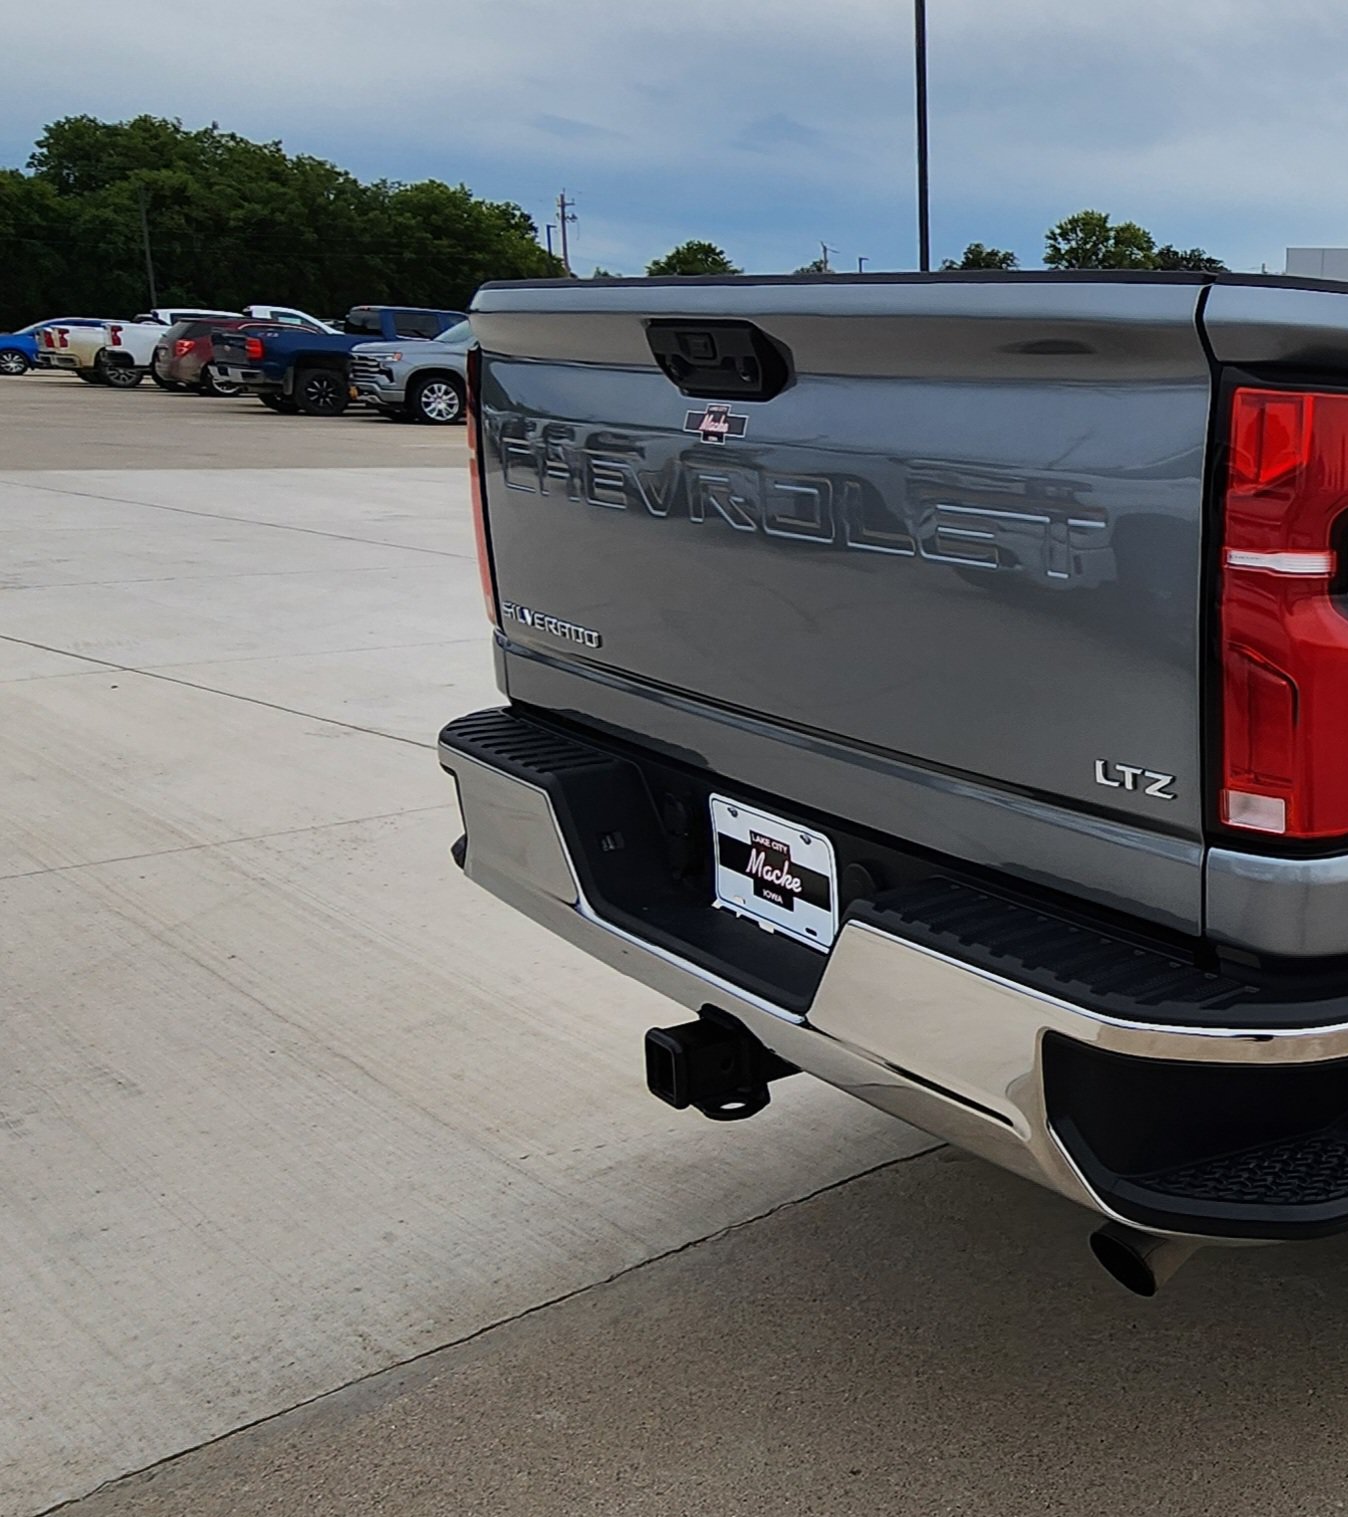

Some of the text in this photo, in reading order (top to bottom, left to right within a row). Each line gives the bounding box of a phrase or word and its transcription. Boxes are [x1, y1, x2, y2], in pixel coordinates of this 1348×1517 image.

[502, 436, 1108, 578] CHEVROLET
[501, 601, 602, 649] SILVERADO
[1095, 759, 1176, 799] LTZ
[752, 833, 788, 854] LAKE CITY
[745, 848, 802, 893] Macke
[762, 888, 784, 904] IOWA
